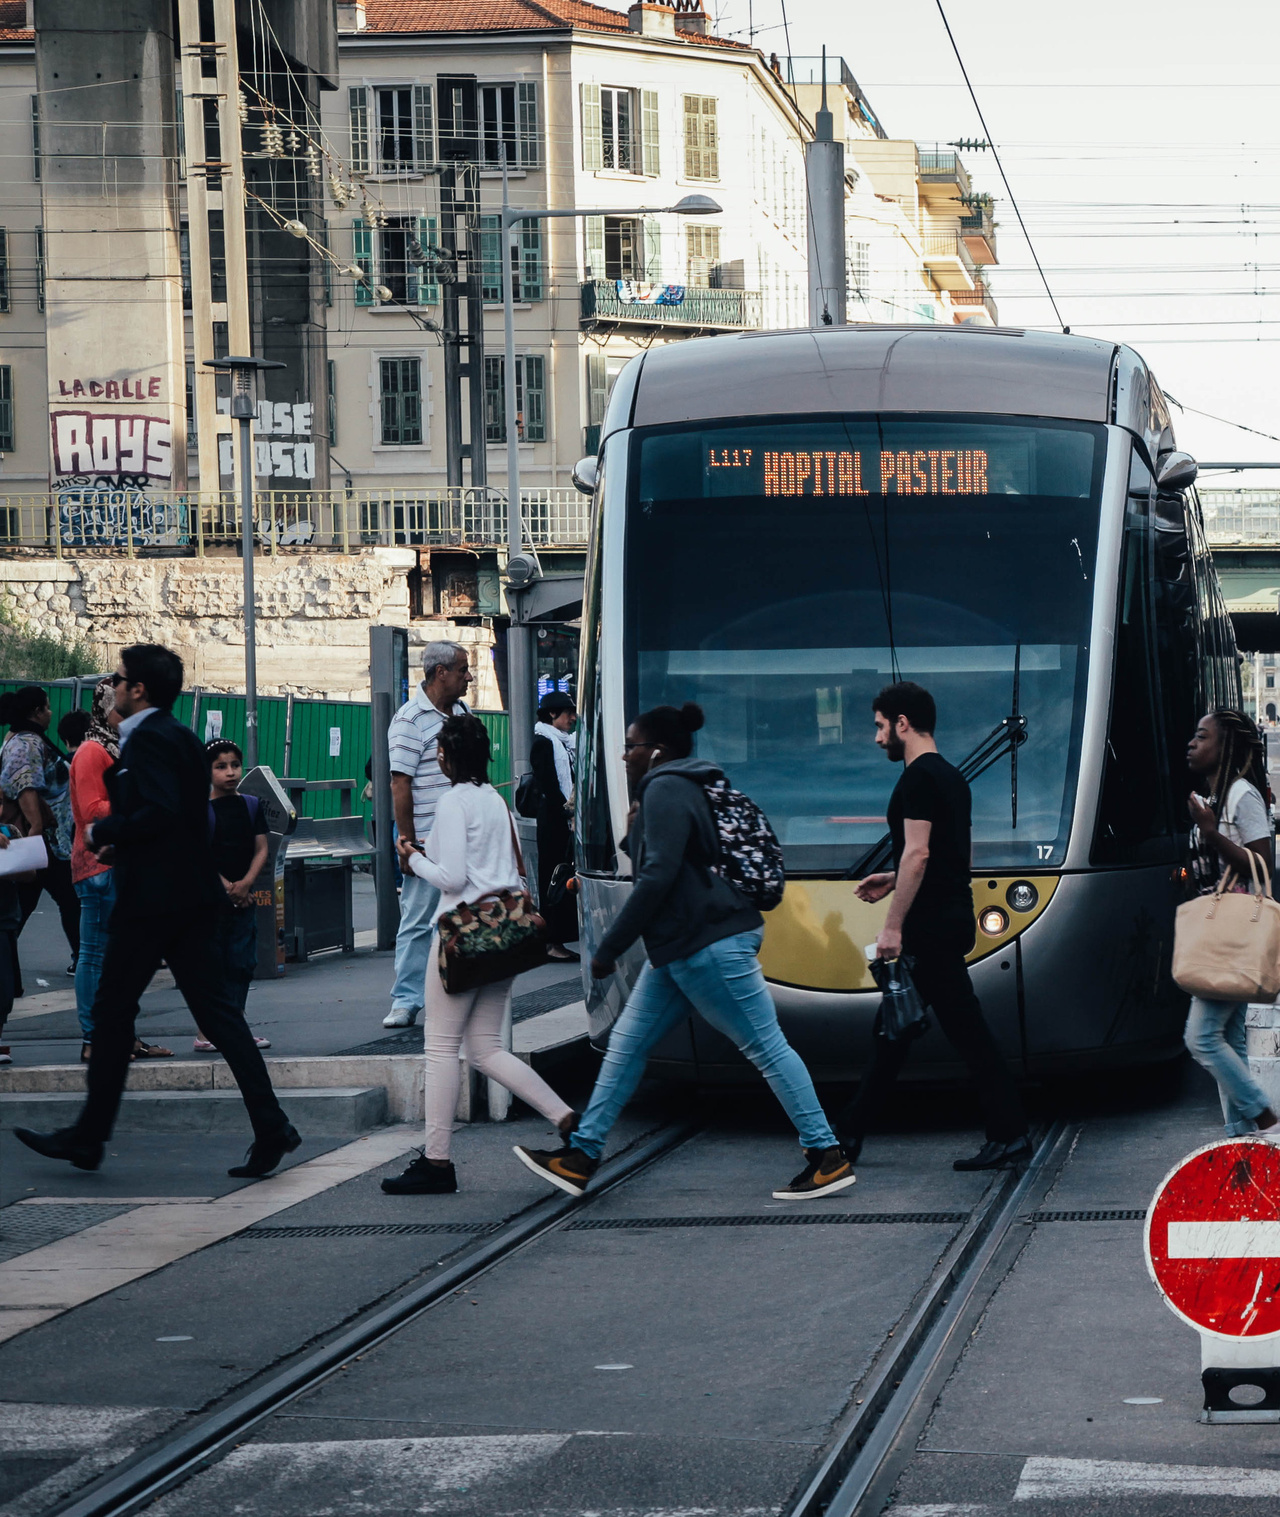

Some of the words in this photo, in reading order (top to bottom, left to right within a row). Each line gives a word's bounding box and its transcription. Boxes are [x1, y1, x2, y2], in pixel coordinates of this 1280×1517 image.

[50, 410, 172, 481] ROYS
[709, 449, 752, 466] L117
[764, 451, 870, 497] HOPITAL
[881, 450, 989, 496] PASTEUR
[1036, 845, 1054, 860] 17
[252, 890, 272, 898] NES
[256, 898, 272, 906] UR
